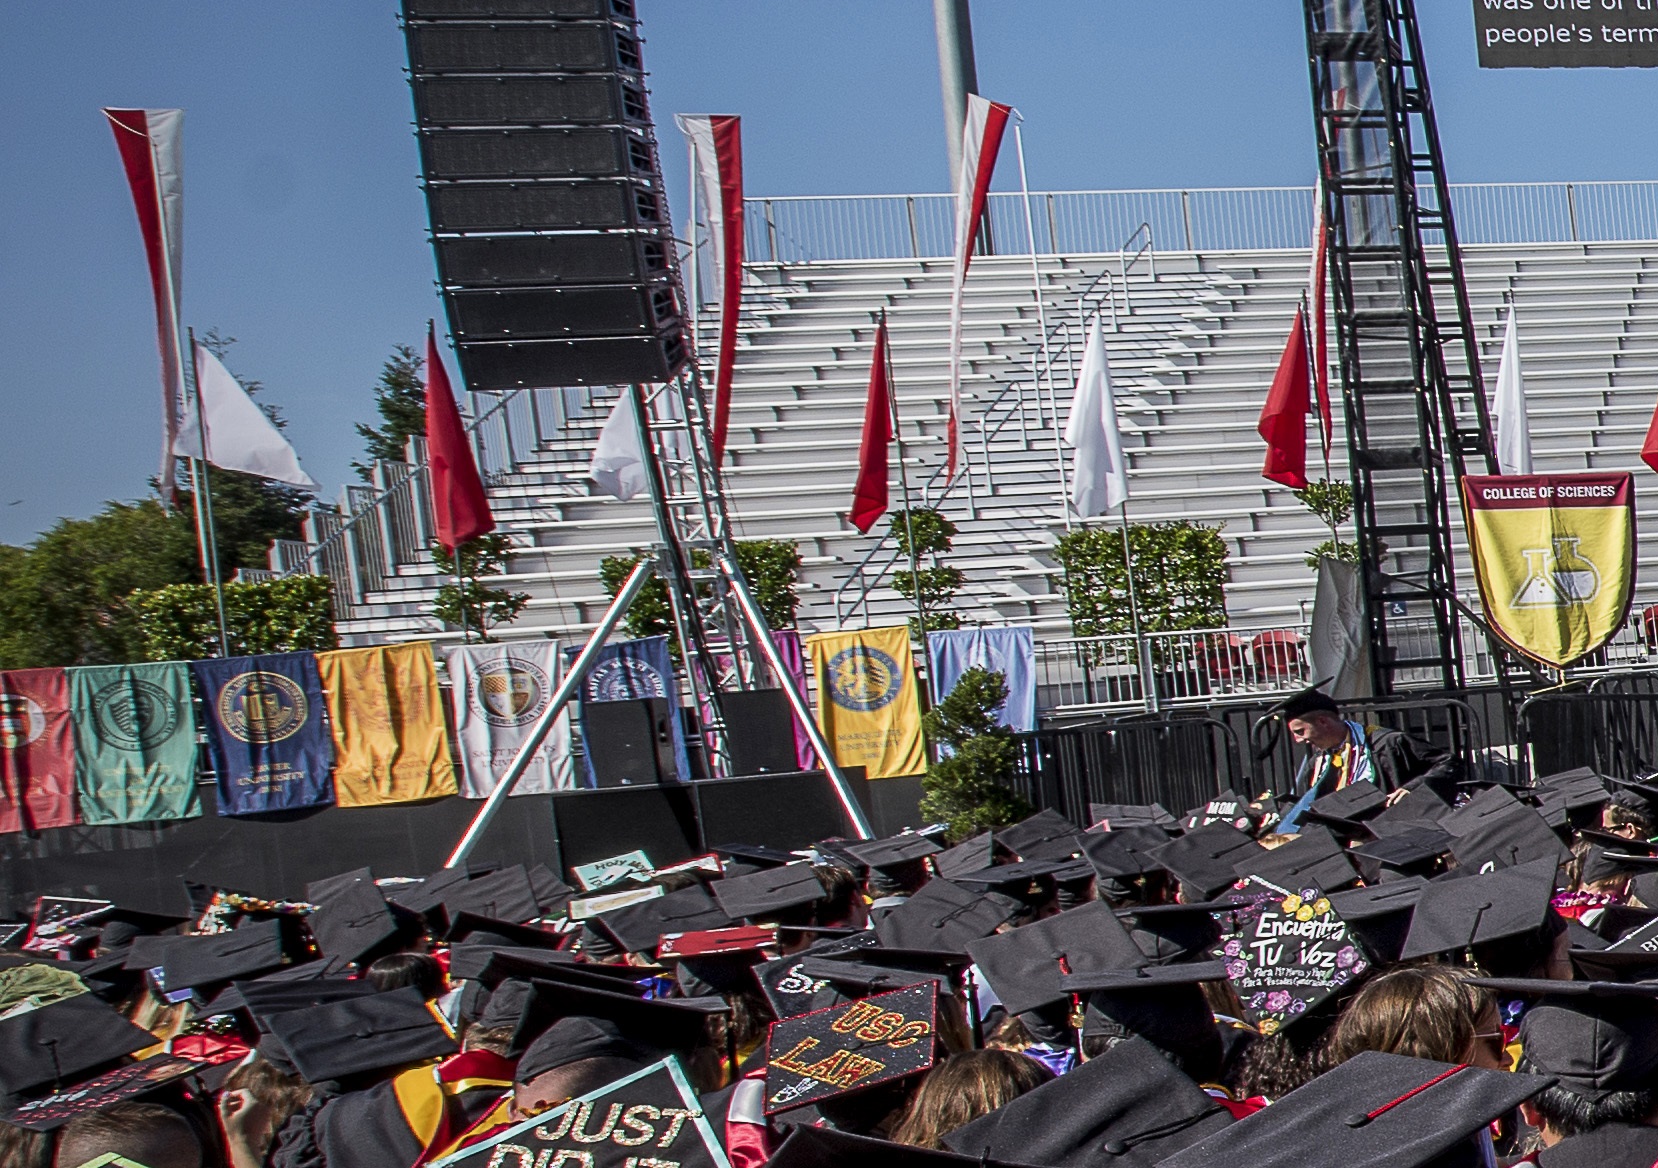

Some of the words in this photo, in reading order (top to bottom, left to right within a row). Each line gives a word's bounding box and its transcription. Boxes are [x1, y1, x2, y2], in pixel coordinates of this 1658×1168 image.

[1485, 23, 1593, 48] people's
[1482, 487, 1537, 500] COLLEGE
[1539, 486, 1554, 499] OF
[1556, 485, 1616, 499] SCIENCES
[1206, 801, 1238, 815] MOM
[1255, 912, 1346, 941] Encuentra
[1250, 938, 1284, 967] Tu
[1253, 967, 1274, 978] Para
[831, 1000, 931, 1049] USC
[769, 1036, 887, 1089] LAW
[535, 1100, 703, 1149] JUST
